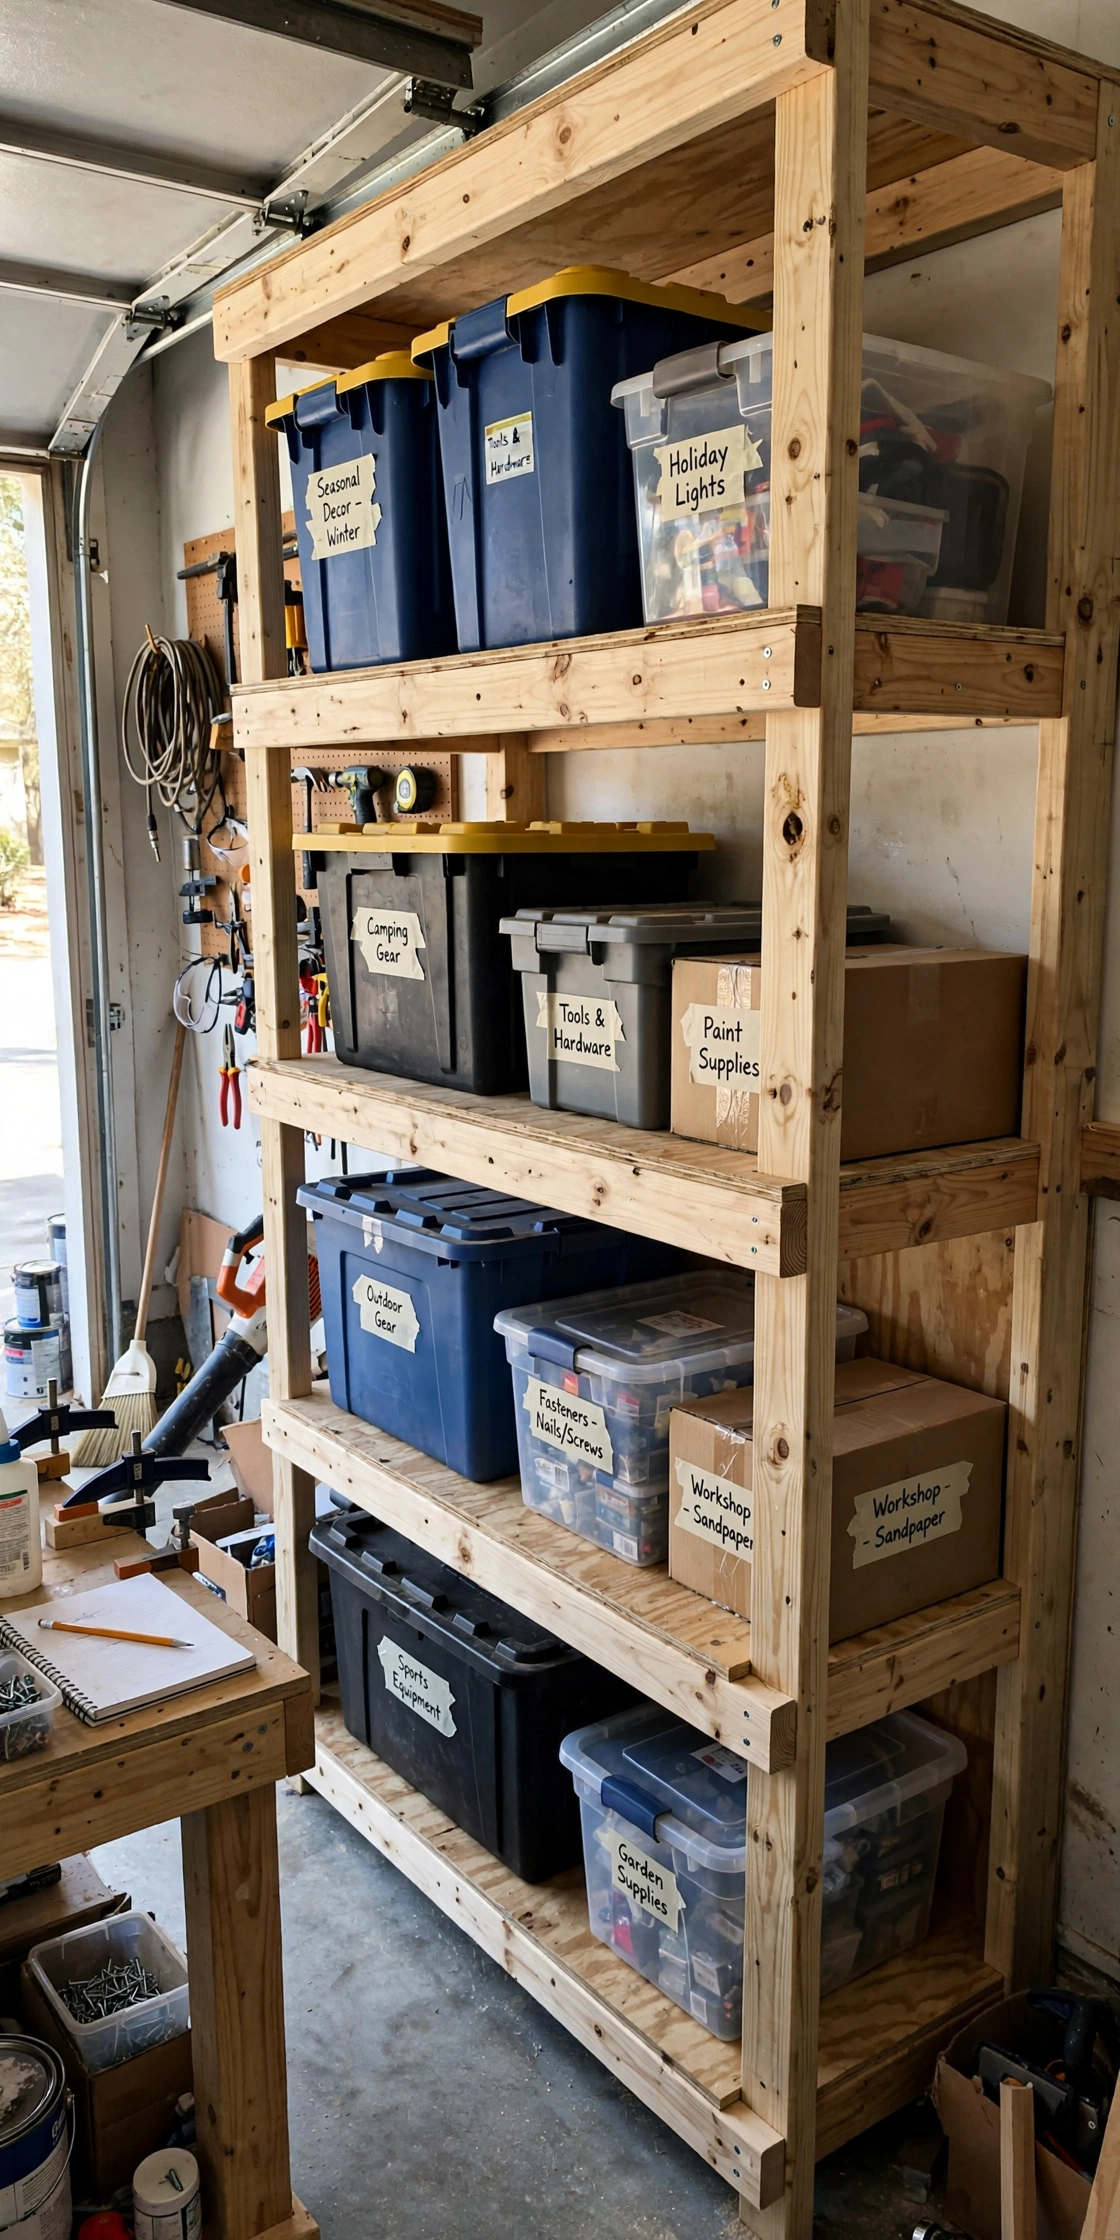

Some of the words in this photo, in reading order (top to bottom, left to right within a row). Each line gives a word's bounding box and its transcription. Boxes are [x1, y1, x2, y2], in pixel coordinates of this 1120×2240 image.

[669, 441, 729, 477] Holiday
[317, 464, 361, 498] Seasonal
[675, 474, 726, 512] Lights
[322, 501, 352, 523] Decor
[326, 522, 361, 547] Winter
[367, 916, 409, 947] Camping
[376, 943, 401, 963] Gear
[558, 1003, 591, 1026] Tools
[594, 1007, 605, 1028] &
[704, 1015, 744, 1043] Paint
[553, 1027, 612, 1057] Hardware
[698, 1046, 760, 1081] Supplies
[366, 1284, 403, 1314] Outdoor
[374, 1310, 397, 1334] Gear
[539, 1388, 589, 1427] Fasteners
[536, 1410, 604, 1459] Nails/Screws
[690, 1473, 751, 1527] Workshop
[872, 1482, 941, 1519] Workshop
[874, 1510, 946, 1549] Sandpaper
[398, 1654, 429, 1690] Sports
[392, 1670, 441, 1721] Equipment
[618, 1843, 664, 1890] Garden
[617, 1864, 668, 1916] Supplies
